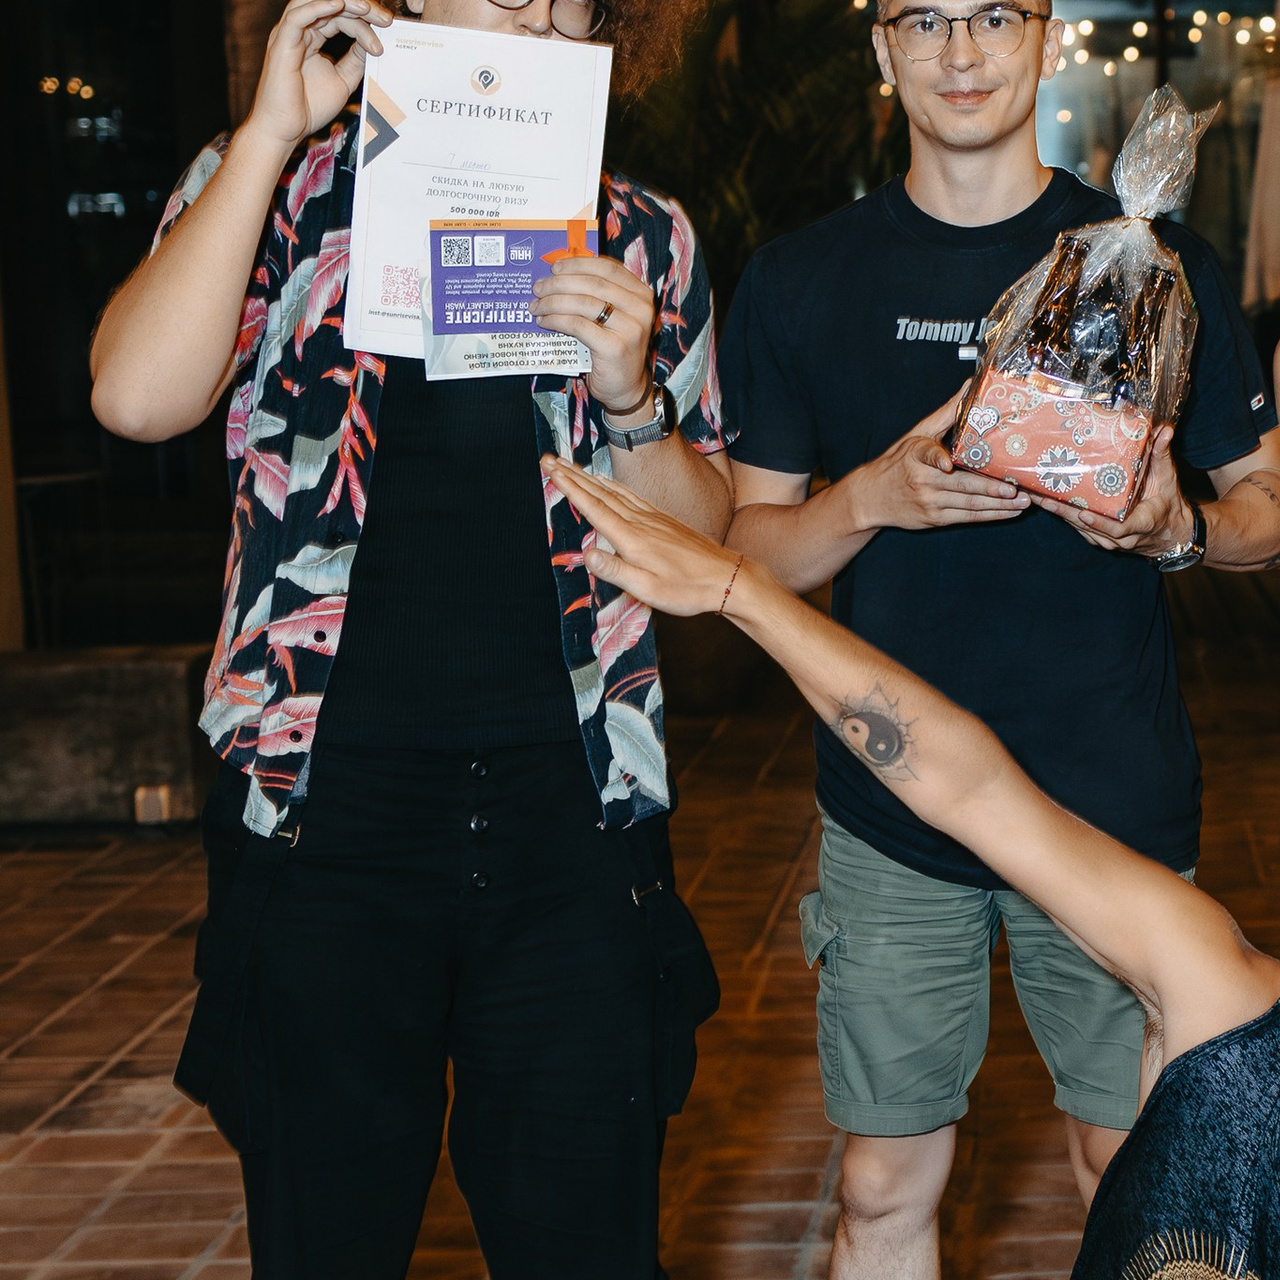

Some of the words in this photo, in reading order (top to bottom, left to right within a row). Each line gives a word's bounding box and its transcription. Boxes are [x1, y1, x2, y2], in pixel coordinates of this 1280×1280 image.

[416, 98, 553, 126] СЕРТИФИКАТ
[431, 175, 469, 188] СКИДКА
[472, 180, 485, 189] НА
[488, 182, 525, 193] ЛЮБУЮ
[425, 188, 502, 204] ДОЛГОСРОЧНУЮ
[504, 196, 529, 206] ВИЗУ
[450, 206, 466, 214] 500
[468, 208, 485, 217] 000
[486, 210, 500, 218] IDR
[510, 249, 531, 260] HALO
[466, 302, 494, 310] HELMET
[445, 310, 533, 324] CERTIFICATE
[896, 318, 975, 345] Tommy
[525, 340, 578, 348] СЛАВЯНСКАЯ
[518, 350, 540, 358] ДЕНЬ
[541, 349, 578, 357] КАЖДЫЙ
[469, 361, 491, 369] ЕДОЙ
[492, 360, 530, 368] ГОТОВОЙ
